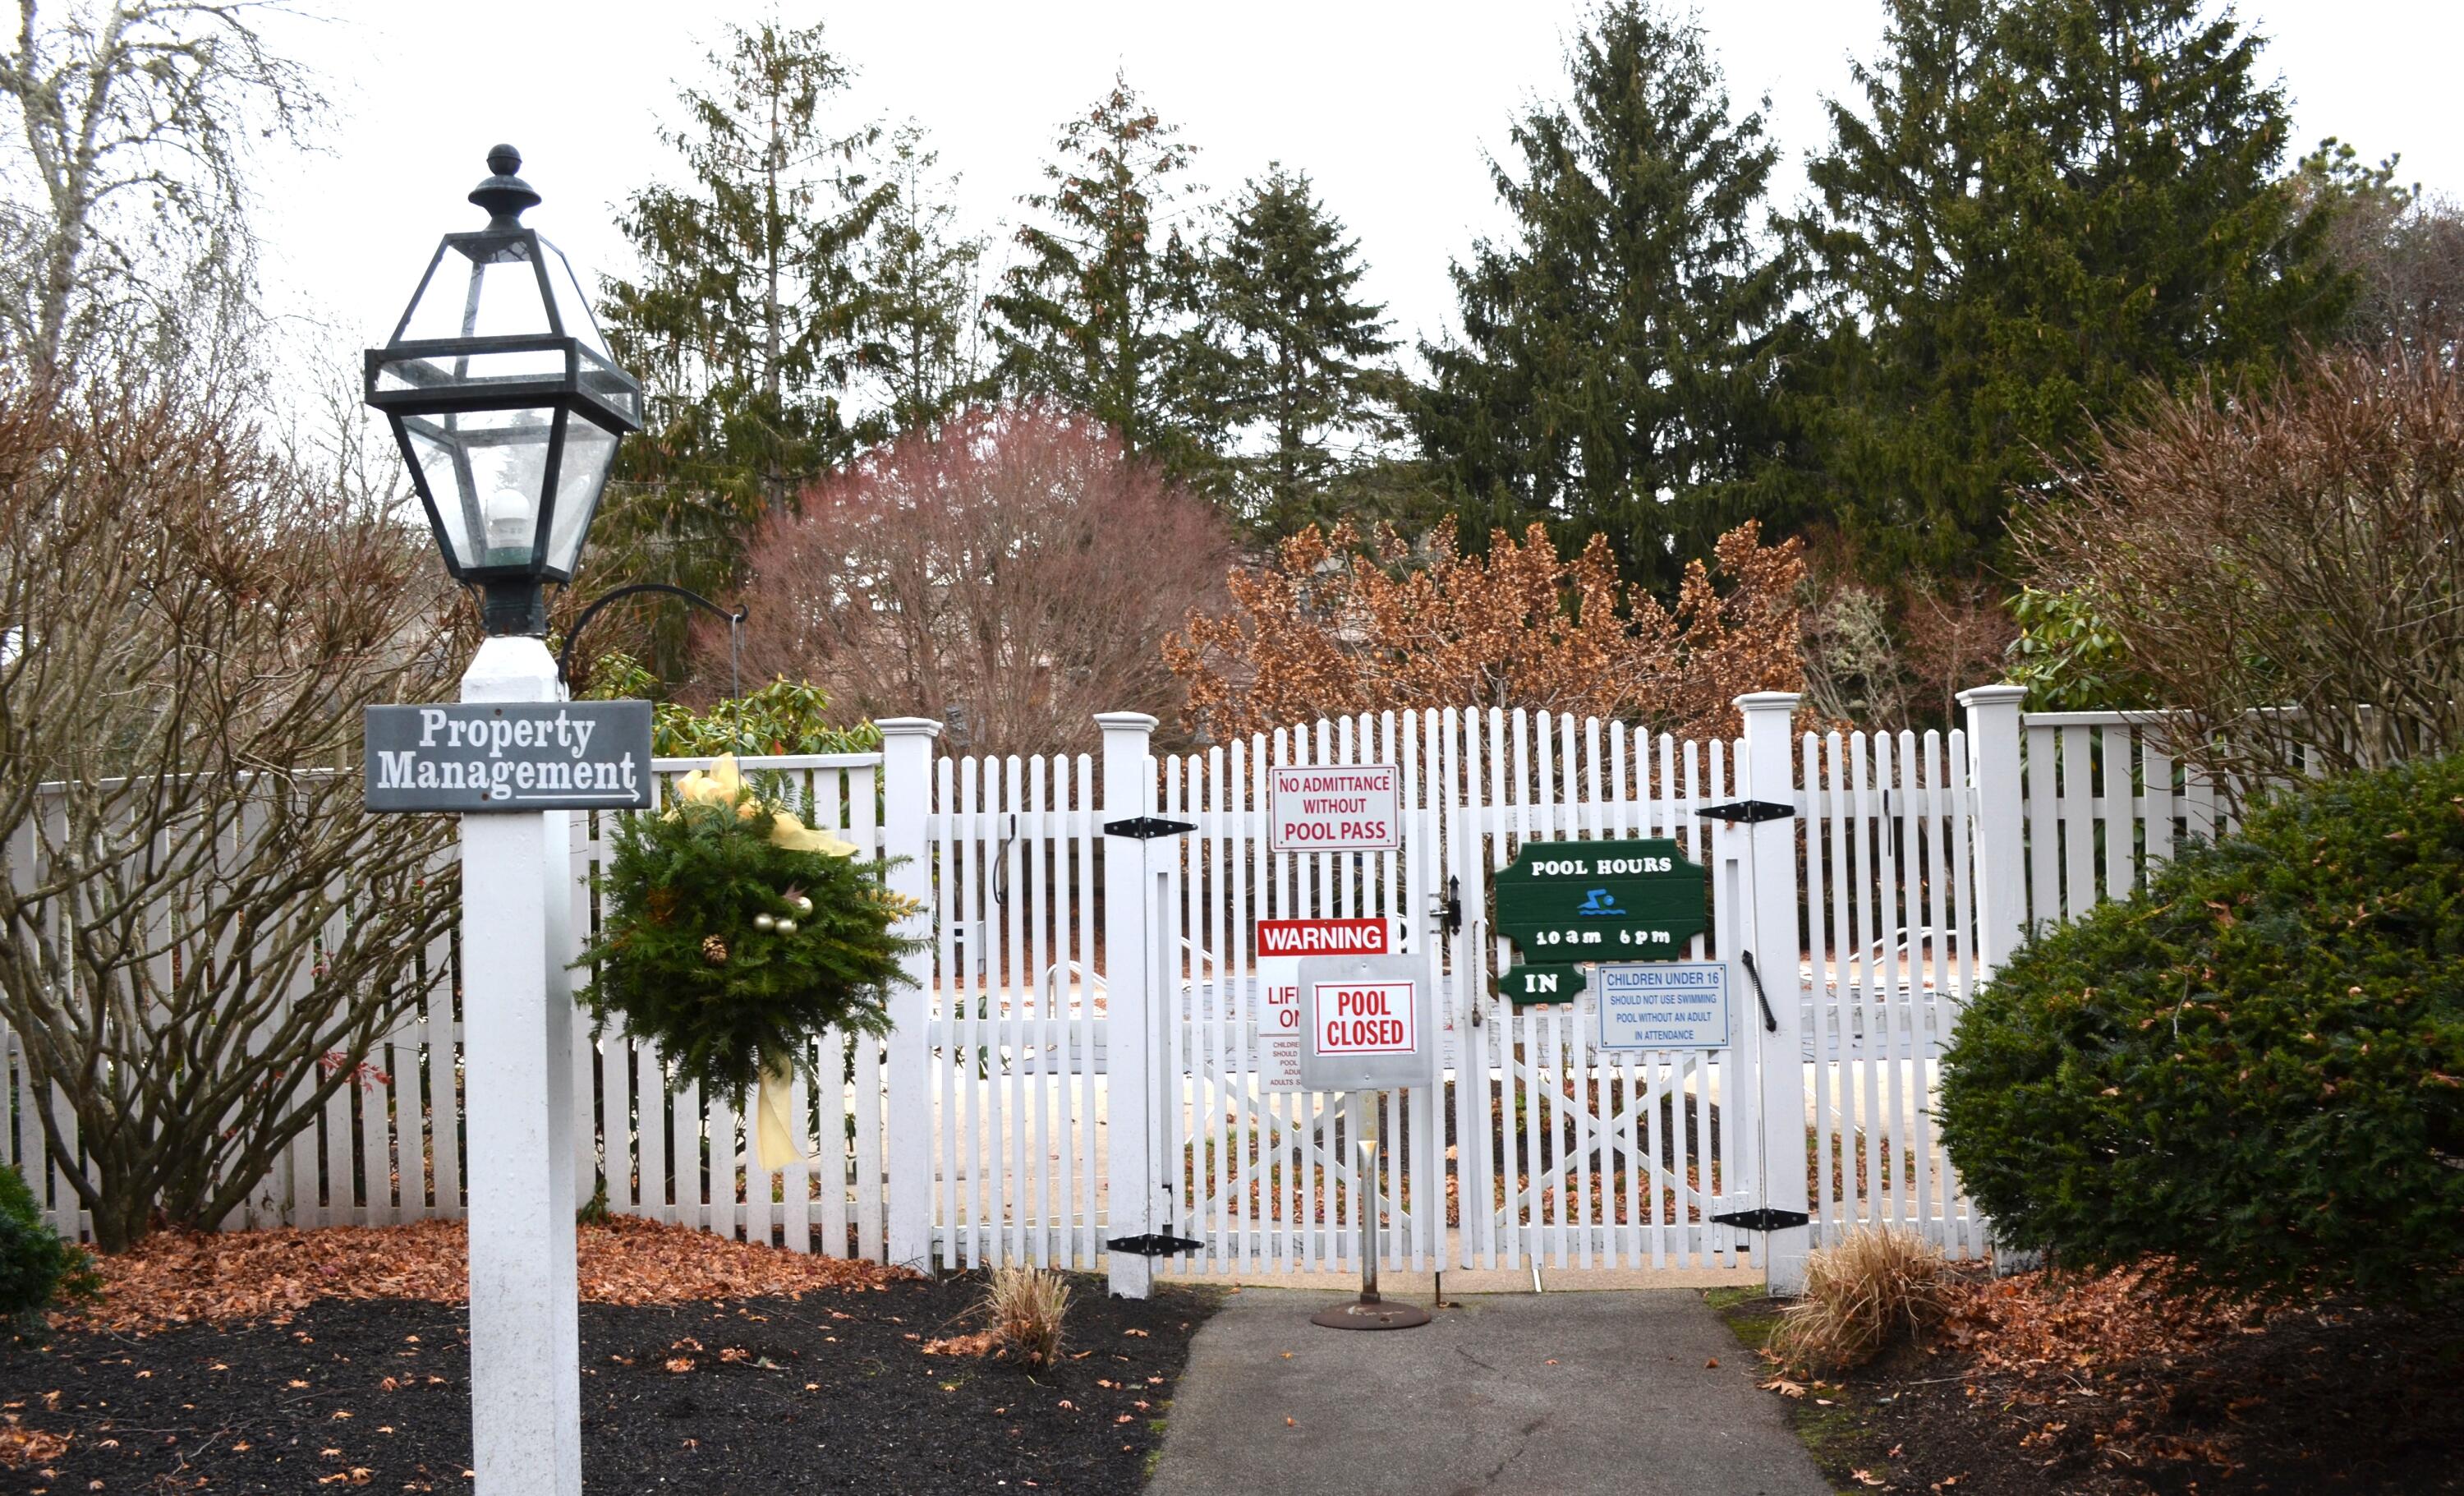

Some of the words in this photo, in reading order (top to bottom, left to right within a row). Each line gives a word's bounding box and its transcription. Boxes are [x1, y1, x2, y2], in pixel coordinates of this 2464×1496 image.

[419, 709, 595, 758] Property
[377, 751, 637, 800] Management
[1280, 778, 1299, 792] NO
[1303, 776, 1390, 792] ADMITTANCE
[1303, 799, 1366, 813] WITHOUT
[1285, 823, 1335, 840] POOL
[1341, 822, 1386, 839] PASS
[1532, 861, 1588, 876] POOL
[1597, 858, 1671, 874] HOURS
[1264, 926, 1381, 950] WARNING
[1525, 974, 1557, 992] IN
[1607, 974, 1662, 985] CHILDREN
[1666, 973, 1703, 984] UNDER
[1708, 973, 1718, 983] 16
[1338, 991, 1391, 1016] POOL
[1611, 996, 1641, 1005] SHOULD
[1643, 996, 1658, 1004] NOT
[1661, 995, 1675, 1004] USE
[1678, 994, 1717, 1004] SWIMMING
[1617, 1014, 1637, 1023] POOL
[1639, 1013, 1671, 1022] WITHOUT
[1676, 1013, 1685, 1021] AN
[1688, 1012, 1712, 1021] ADULT
[1327, 1020, 1404, 1046] CLOSED
[1635, 1032, 1643, 1040] IN
[1645, 1030, 1694, 1040] ATTENDANCE
